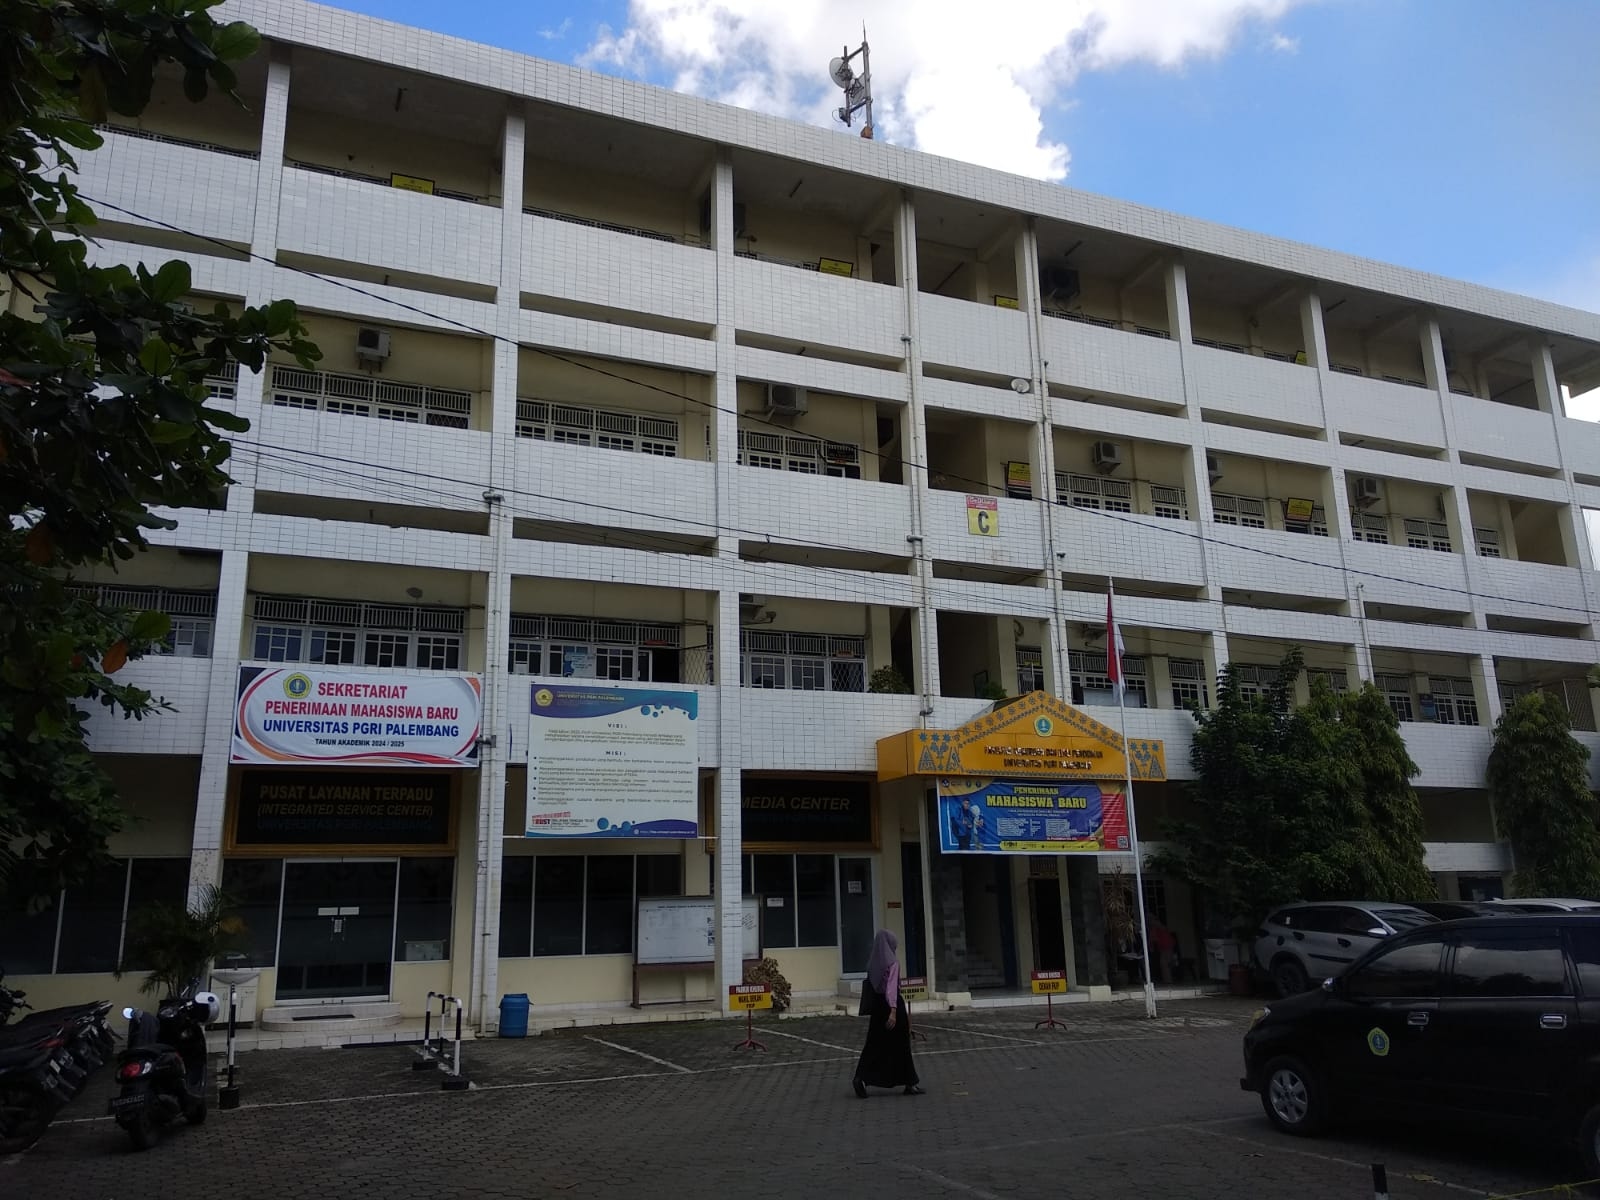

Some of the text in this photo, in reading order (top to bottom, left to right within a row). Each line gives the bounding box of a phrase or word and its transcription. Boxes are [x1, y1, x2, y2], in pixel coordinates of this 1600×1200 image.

[978, 511, 989, 534] C
[318, 682, 408, 699] SEKRETARIAT
[265, 701, 458, 720] PENERIMAAN MAHASISWA BARU
[263, 720, 459, 737] UNIVERSITAS PGRI PALEMBANG
[259, 784, 433, 801] PUSAT LAYANAN TERPADU
[257, 803, 433, 817] (INTEGRATED SERVICE CENTER)
[790, 797, 850, 810] CENTER
[986, 795, 1087, 808] MAHASISWA BARU
